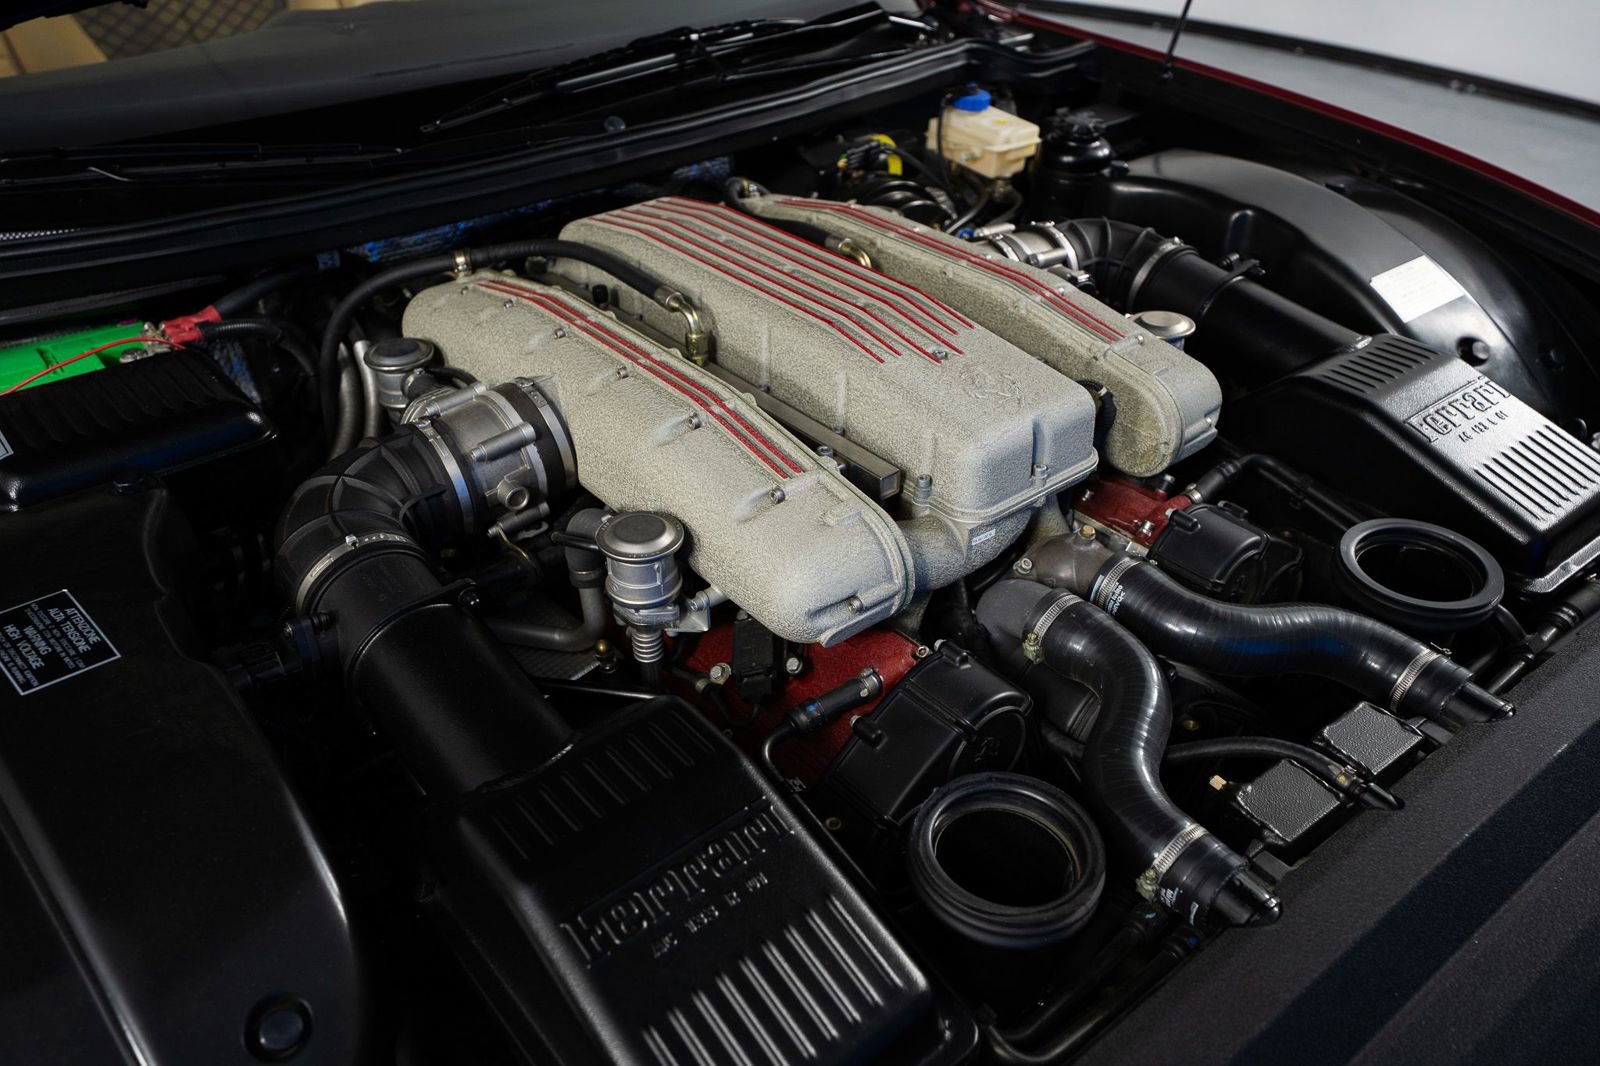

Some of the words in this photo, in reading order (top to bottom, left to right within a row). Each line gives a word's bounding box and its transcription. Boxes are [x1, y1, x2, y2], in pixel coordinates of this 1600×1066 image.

[1403, 375, 1511, 443] Ferrari
[3, 624, 22, 640] HIGH
[16, 640, 45, 670] VOLTAGE
[23, 625, 52, 655] WARNING
[47, 607, 65, 622] ALTA
[60, 621, 91, 653] TENSIONE
[64, 607, 101, 645] ATTENZIONE
[559, 797, 797, 969] Ferrari
